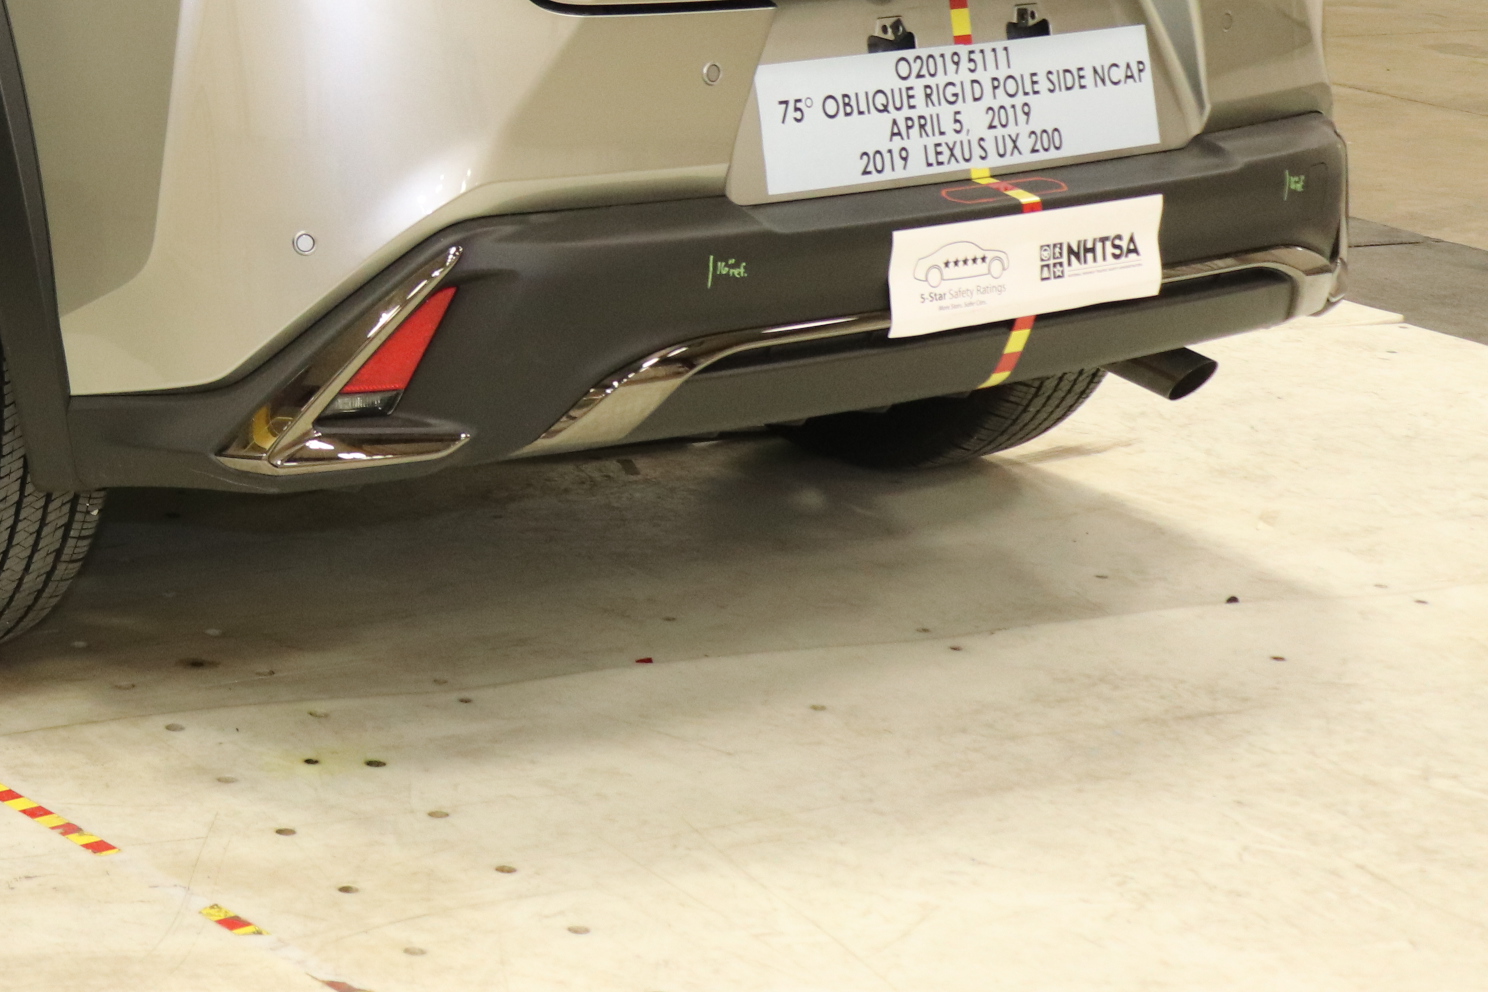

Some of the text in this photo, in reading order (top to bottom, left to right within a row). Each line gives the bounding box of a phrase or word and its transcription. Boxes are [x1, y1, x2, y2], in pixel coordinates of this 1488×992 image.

[822, 85, 916, 119] OBLIQUE
[924, 78, 984, 110] RIGID
[991, 72, 1040, 101] POLE
[1047, 66, 1086, 94] SIDE
[1092, 60, 1146, 89] NCAP
[889, 103, 1032, 143] APRIL 5, 2019
[859, 127, 1063, 176] 2019 LEXUS UX 200
[1067, 232, 1141, 267] NHTSA
[920, 283, 1007, 304] 5-Star Safety Ratings
